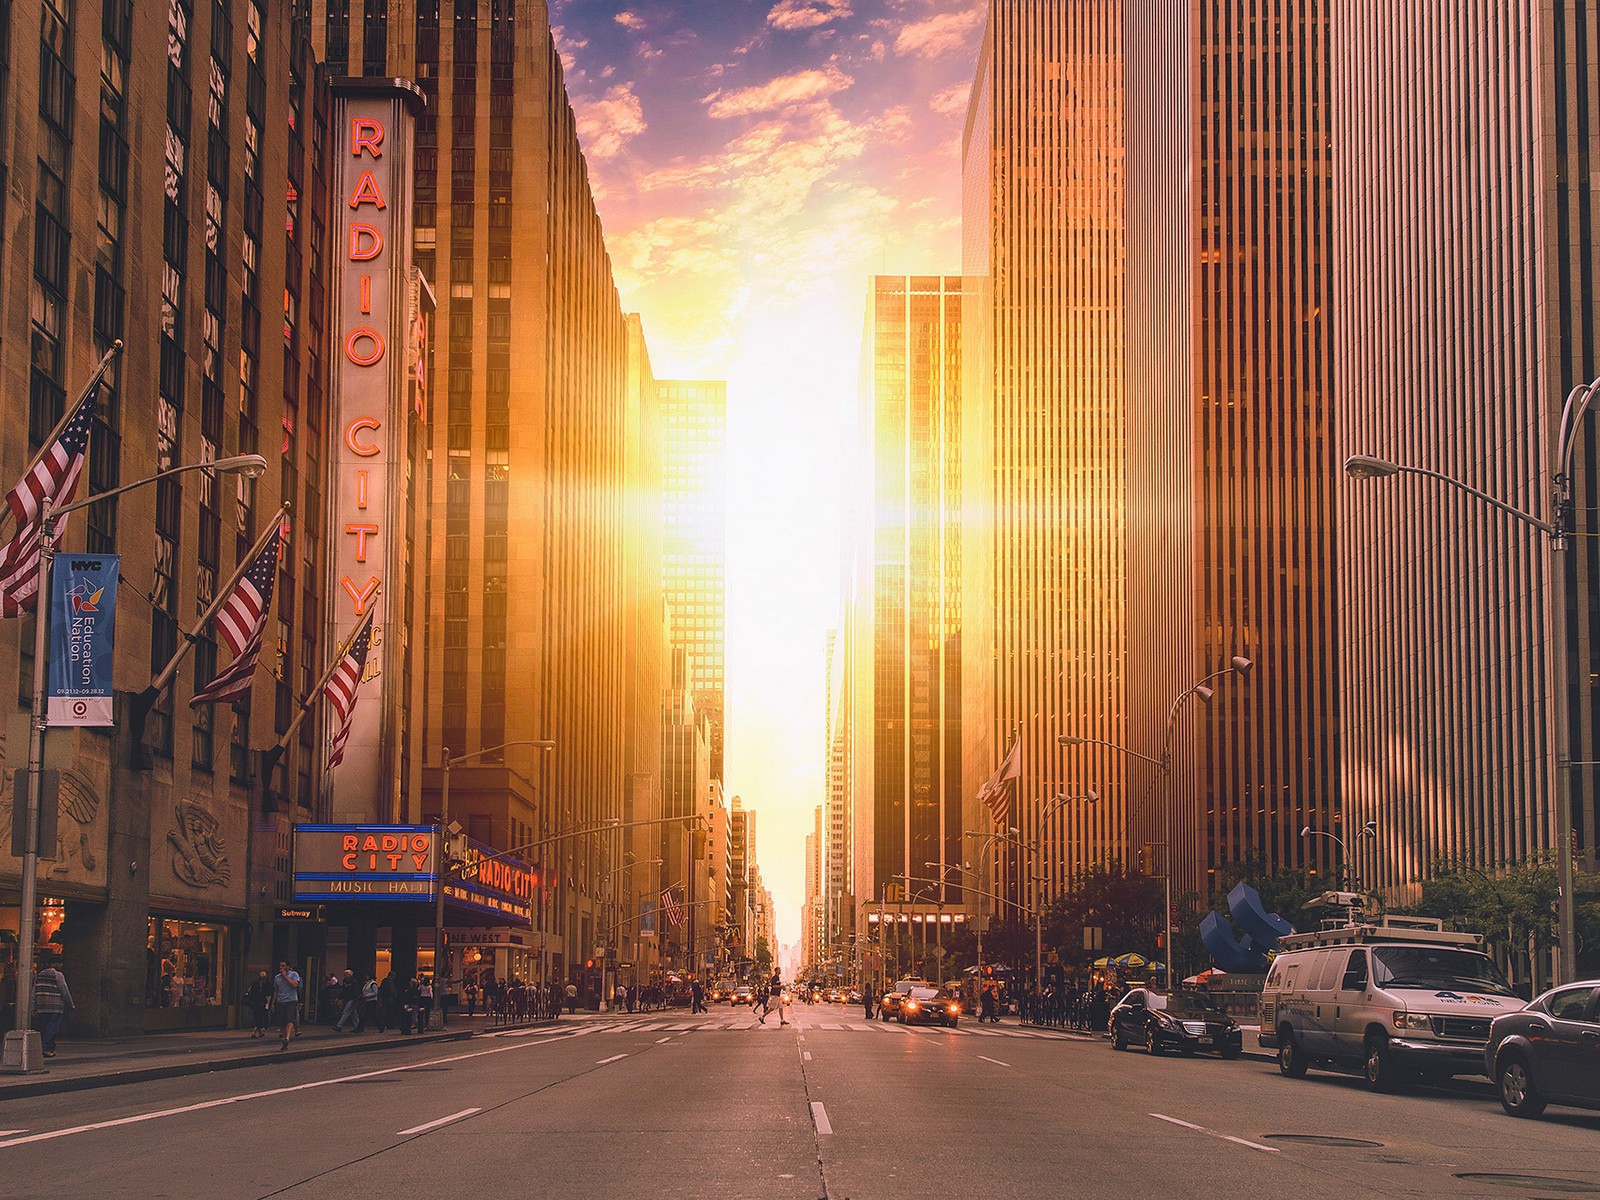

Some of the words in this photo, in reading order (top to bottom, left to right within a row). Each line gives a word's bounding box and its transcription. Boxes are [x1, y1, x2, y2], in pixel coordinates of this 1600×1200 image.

[345, 118, 386, 366] RADIO
[340, 417, 381, 615] CITY
[71, 561, 102, 571] NYC
[71, 617, 83, 662] Nation
[82, 617, 95, 685] Education
[343, 835, 429, 852] RADIO
[342, 853, 428, 870] CITY
[479, 854, 511, 892] RADIO
[330, 881, 373, 893] MUSIC
[388, 881, 428, 893] HALL
[281, 909, 311, 918] Subway
[470, 933, 501, 944] WEST
[1230, 978, 1249, 986] TIME
